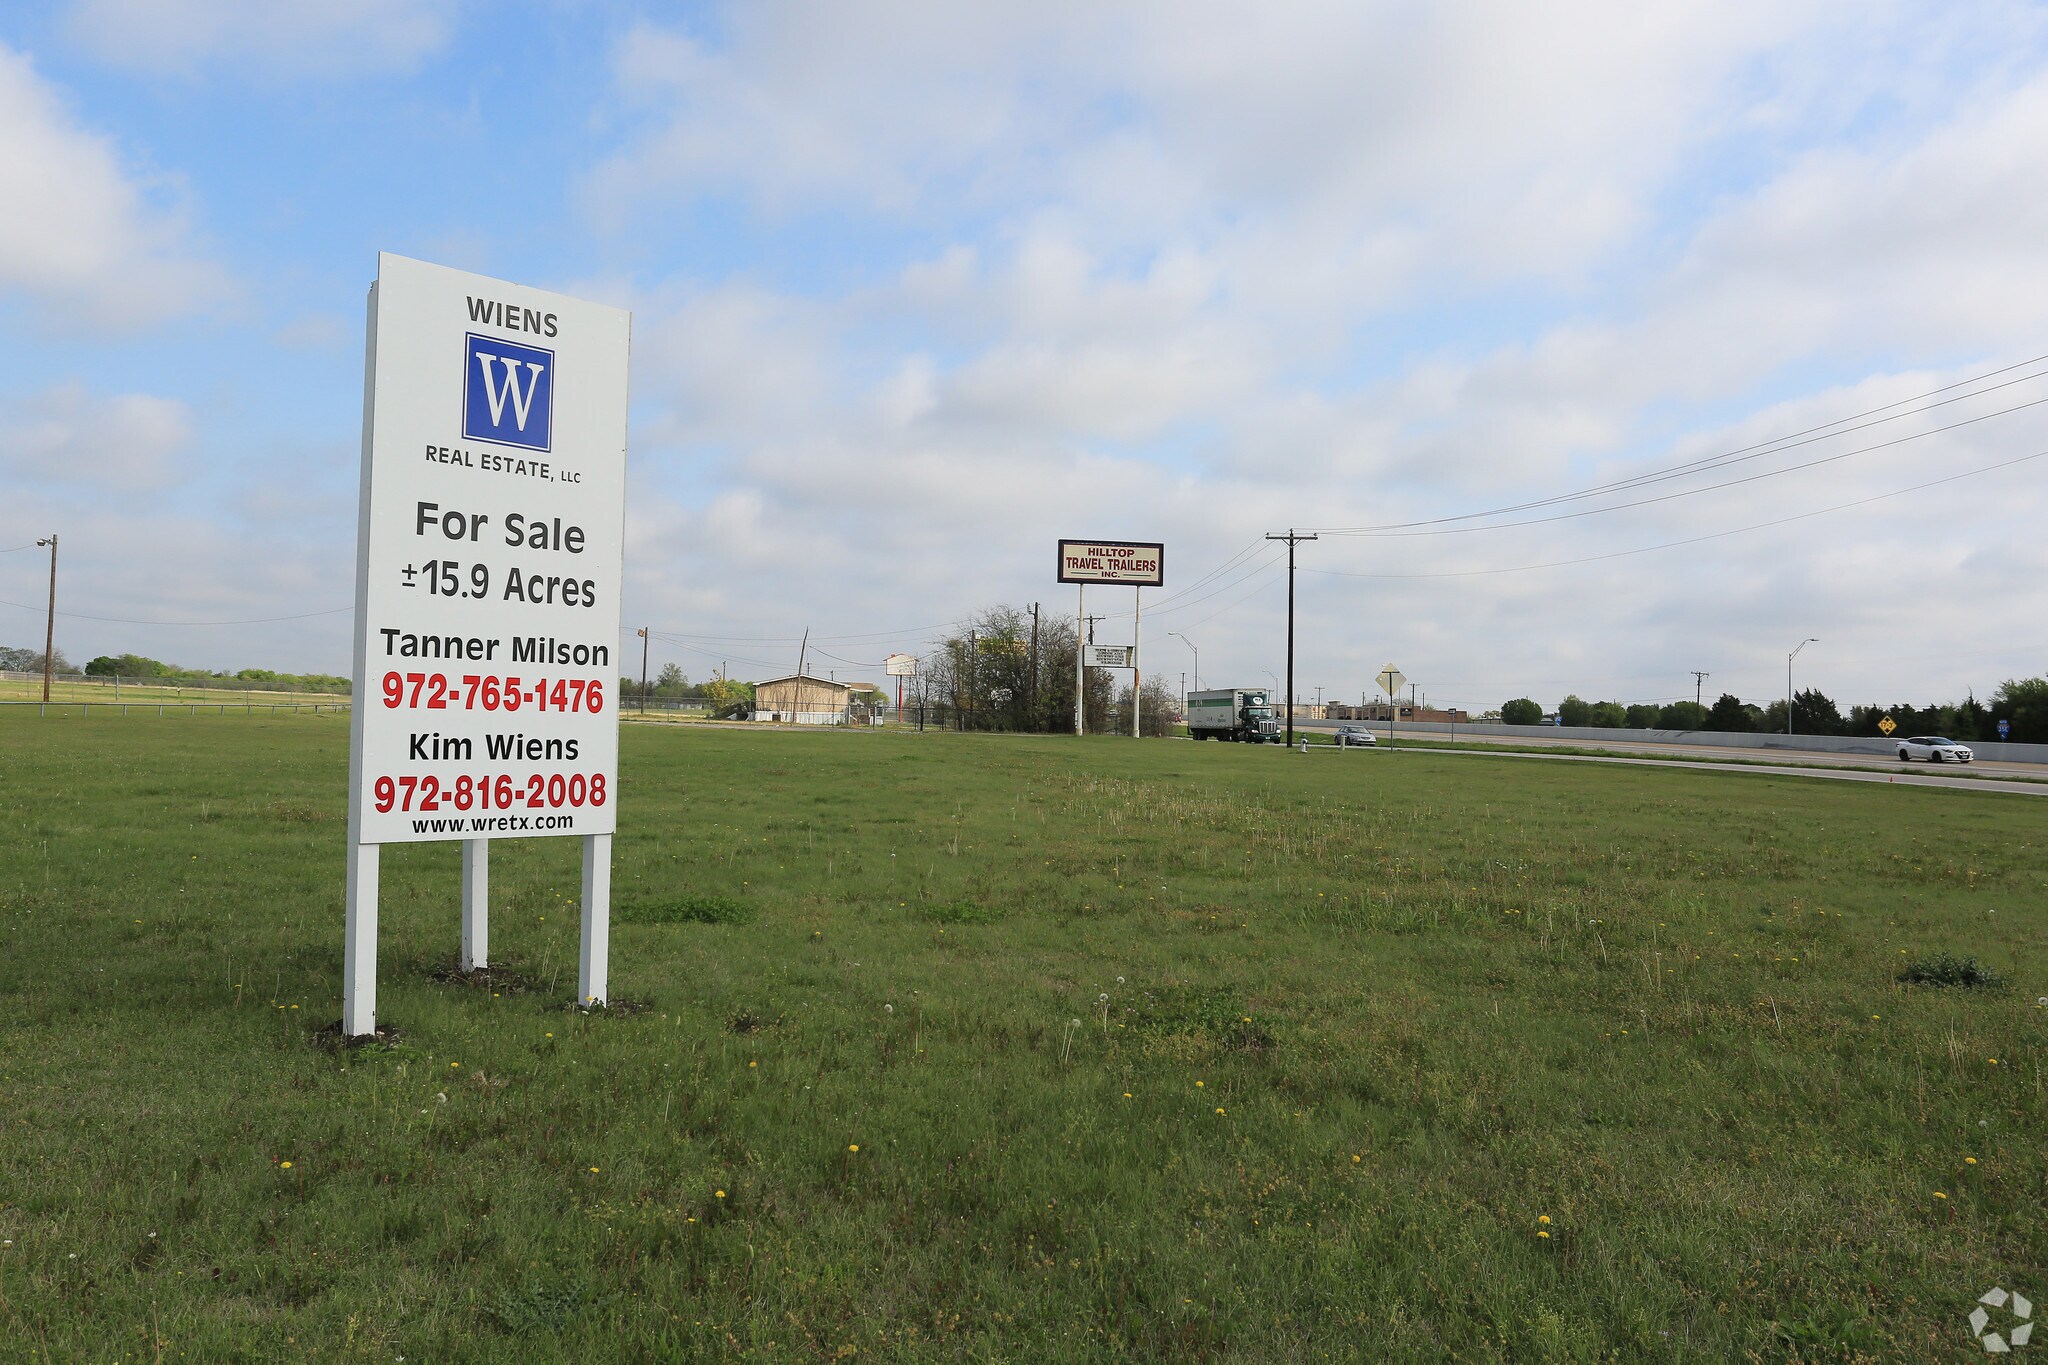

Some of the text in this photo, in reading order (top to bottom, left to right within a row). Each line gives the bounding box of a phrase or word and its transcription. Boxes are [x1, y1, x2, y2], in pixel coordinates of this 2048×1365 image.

[466, 295, 558, 338] WIENS
[475, 351, 545, 432] W
[425, 444, 581, 484] REAL ESTATE, LLC
[416, 501, 585, 554] For Sale
[1066, 556, 1156, 572] TRAVEL TRAILERS
[1088, 547, 1135, 557] HILLTOP
[401, 559, 595, 608] ±15.9 Acres
[380, 628, 609, 667] Tanner Milson
[382, 671, 604, 714] 972-765-1476
[409, 732, 579, 761] Kim Wiens
[374, 773, 607, 814] 972-816-2008
[412, 814, 573, 834] www.wretx.com
